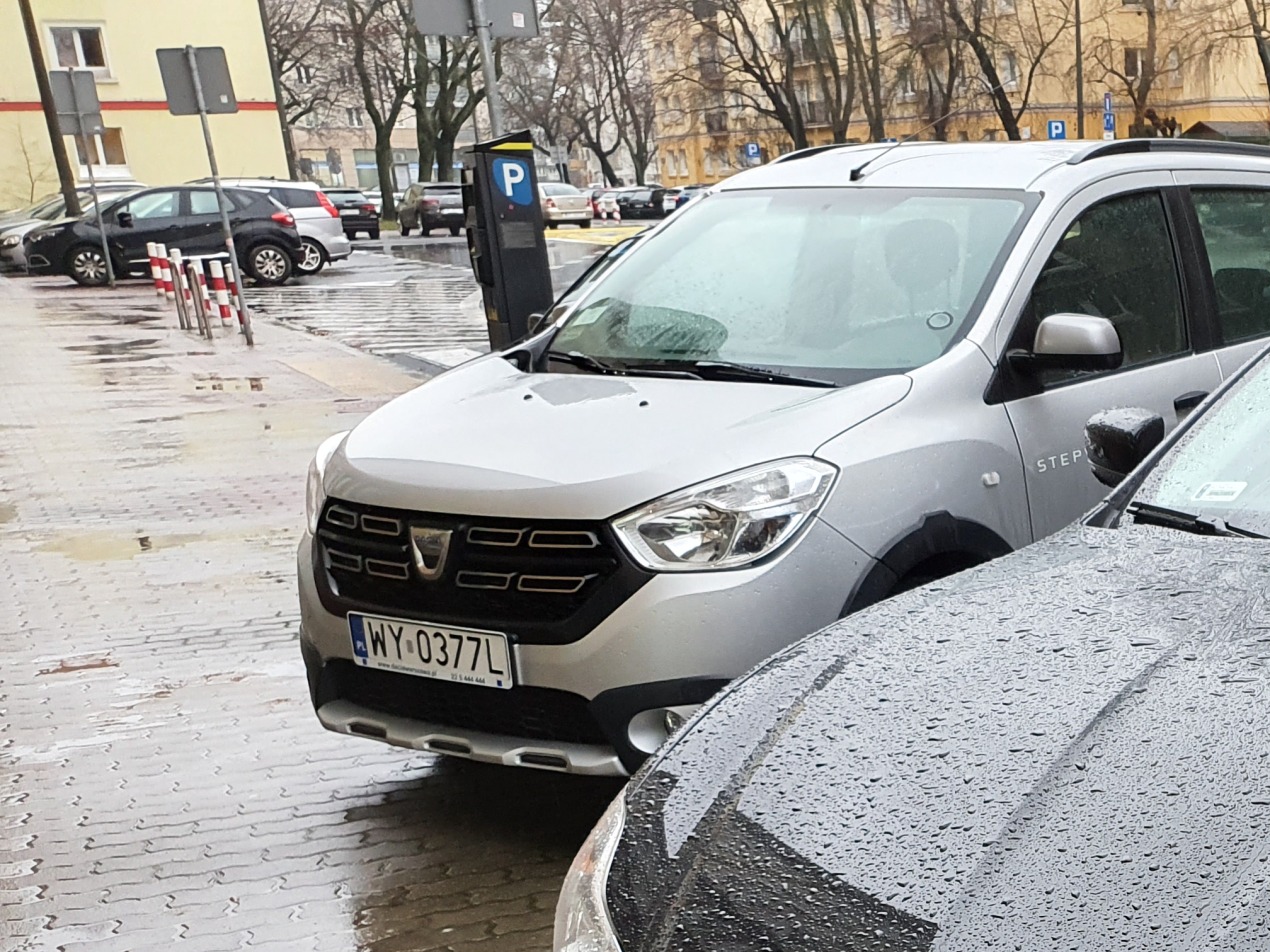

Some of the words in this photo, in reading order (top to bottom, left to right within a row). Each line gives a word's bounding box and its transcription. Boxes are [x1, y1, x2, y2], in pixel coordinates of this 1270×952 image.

[1051, 122, 1063, 138] P
[502, 162, 525, 197] P
[355, 640, 368, 652] PL
[367, 621, 404, 660] WY
[416, 629, 504, 675] 0377L
